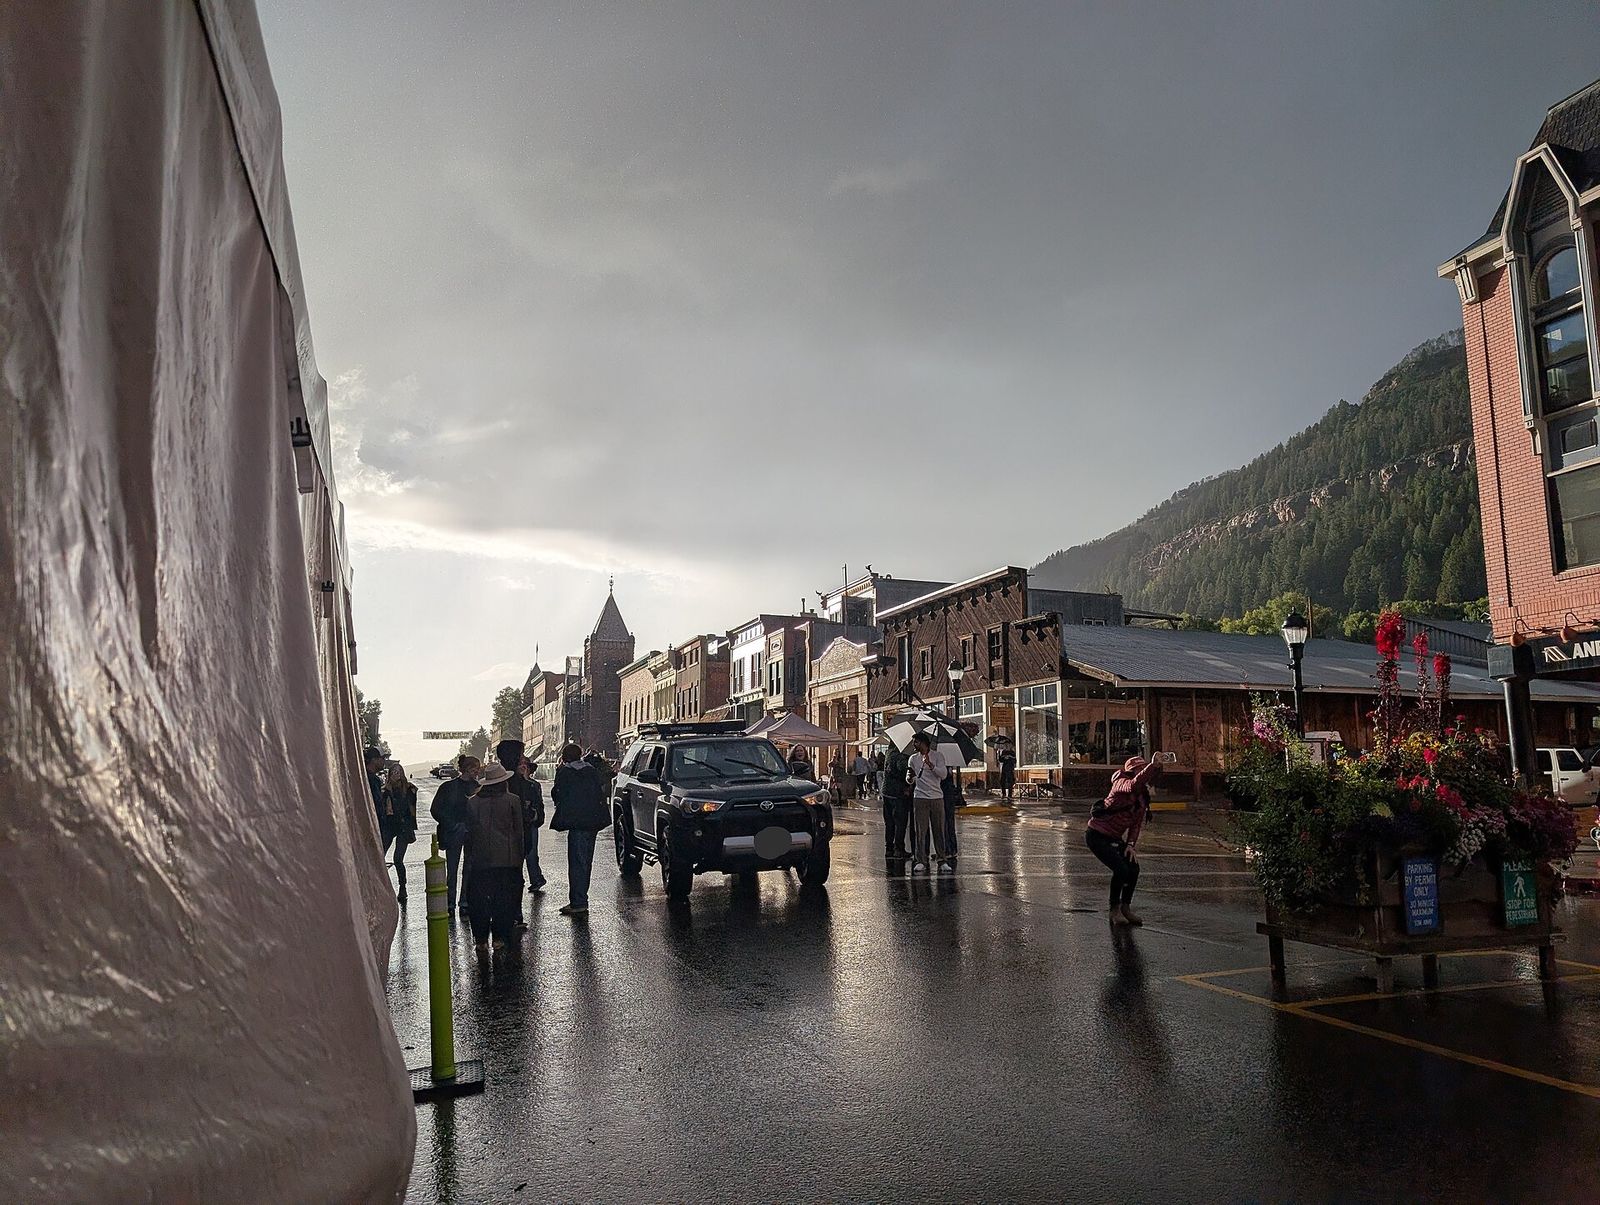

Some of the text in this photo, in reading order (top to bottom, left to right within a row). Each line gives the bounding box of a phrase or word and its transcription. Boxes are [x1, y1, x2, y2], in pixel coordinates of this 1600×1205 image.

[1407, 864, 1433, 874] PARKING
[1404, 873, 1437, 887] BY PERMIT
[1413, 886, 1429, 897] ONLY
[1506, 898, 1536, 910] STOP FOR
